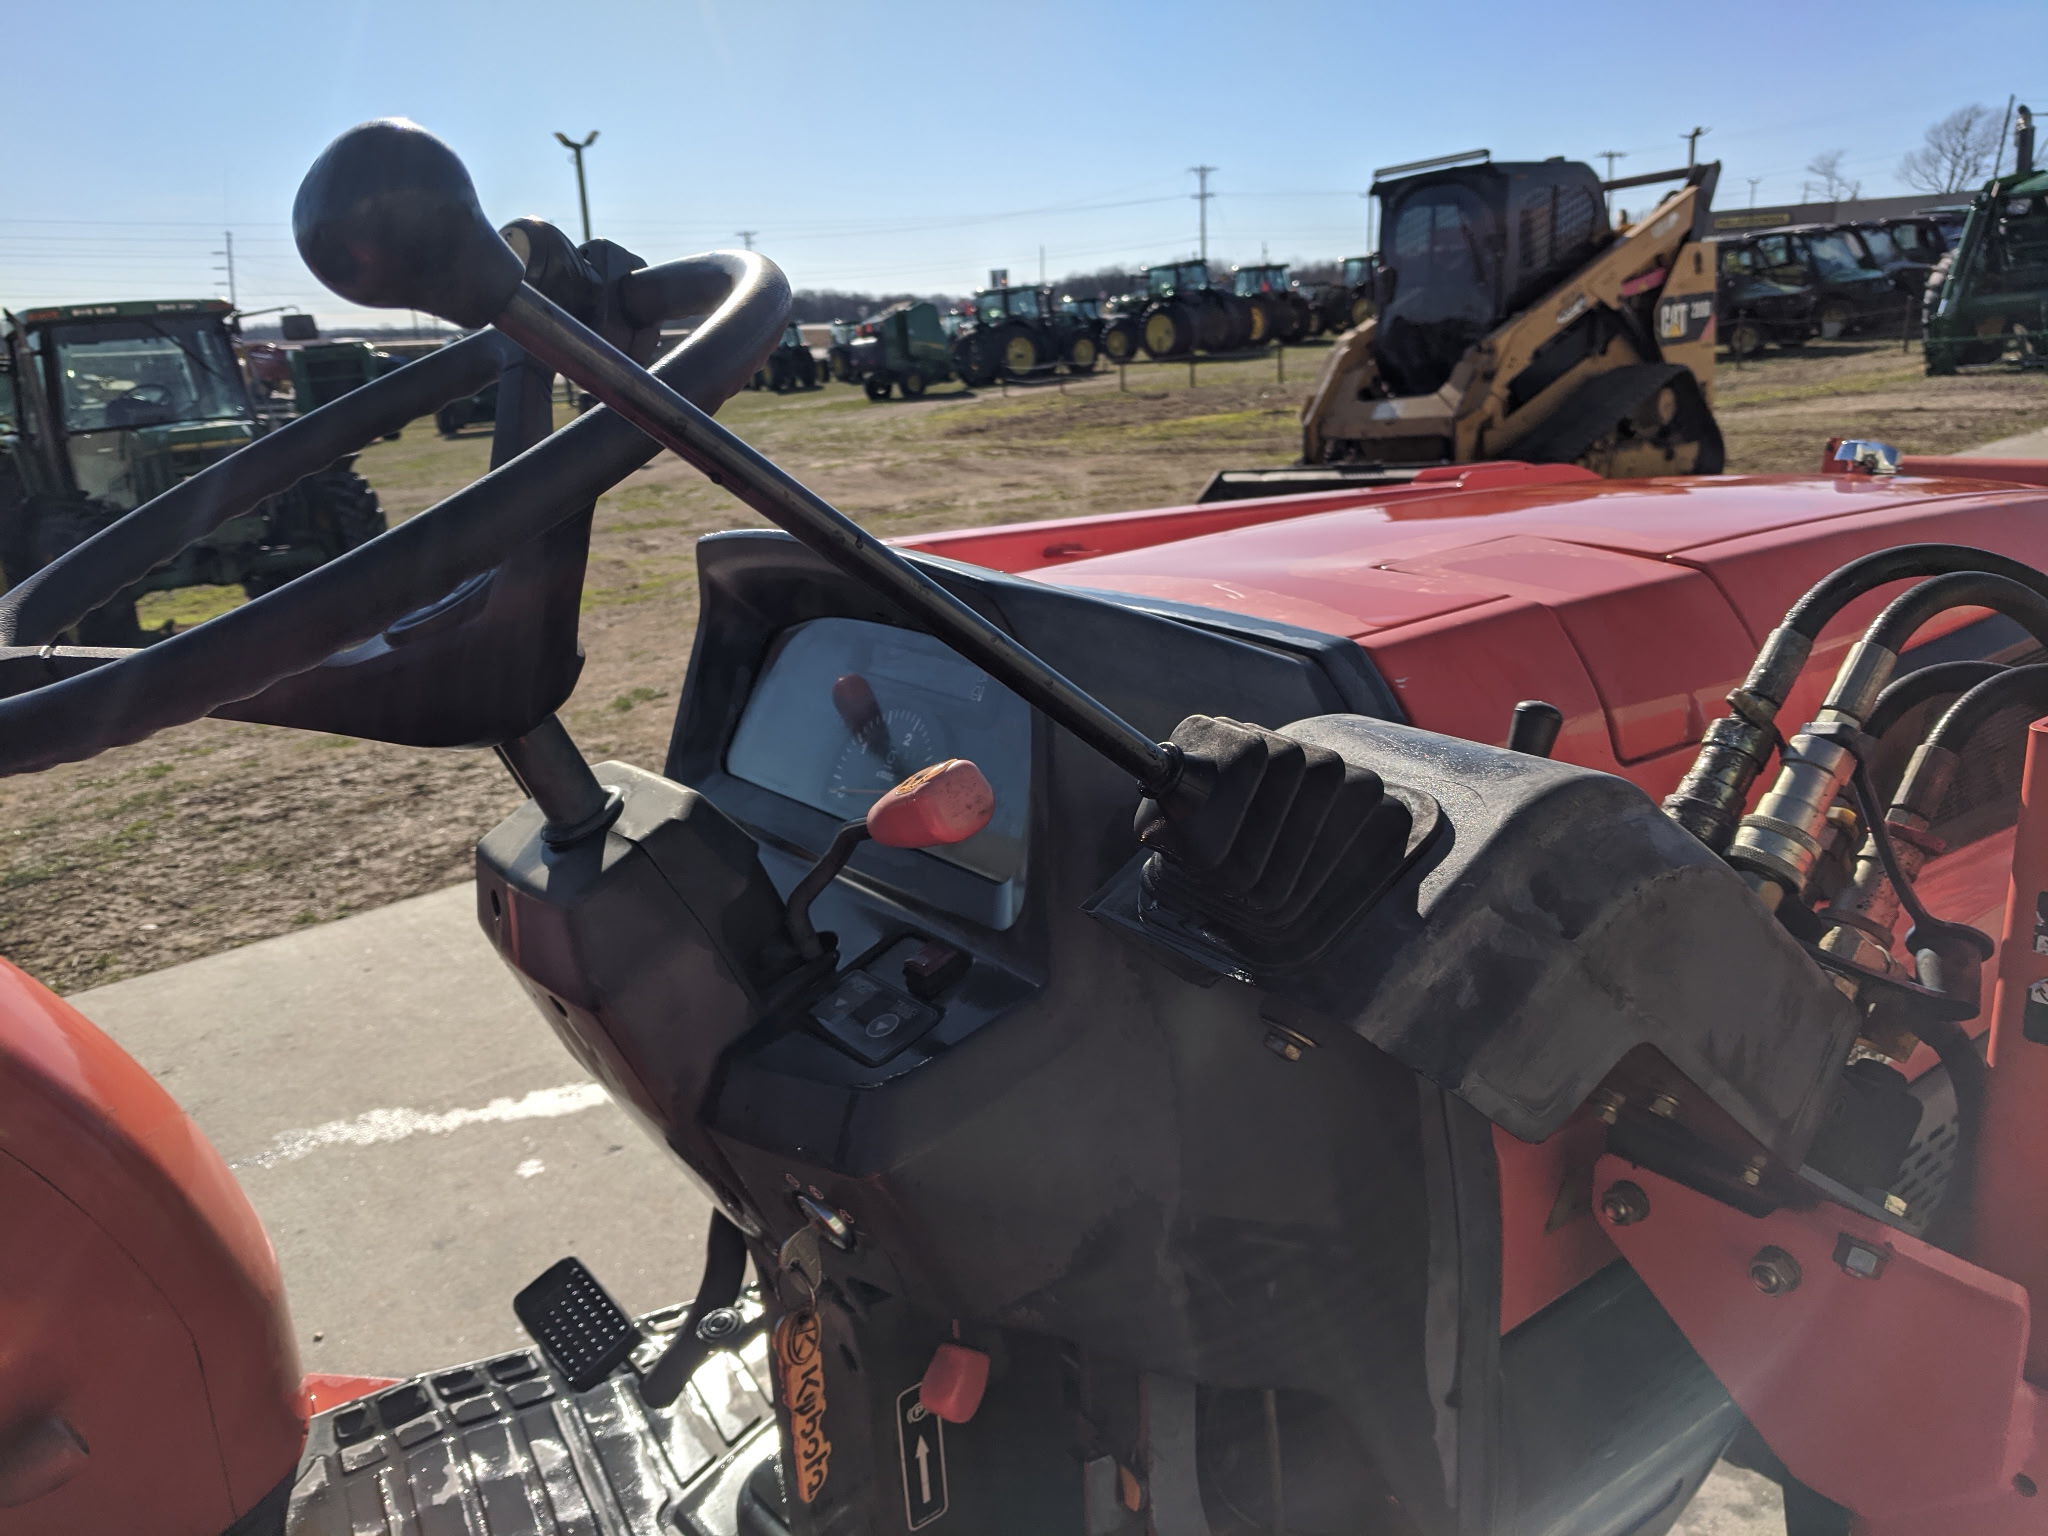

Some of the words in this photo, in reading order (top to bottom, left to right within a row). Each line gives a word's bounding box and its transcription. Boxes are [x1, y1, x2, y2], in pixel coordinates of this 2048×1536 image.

[1661, 303, 1688, 338] CAT
[903, 733, 913, 746] 2
[795, 1364, 828, 1497] Kubota
